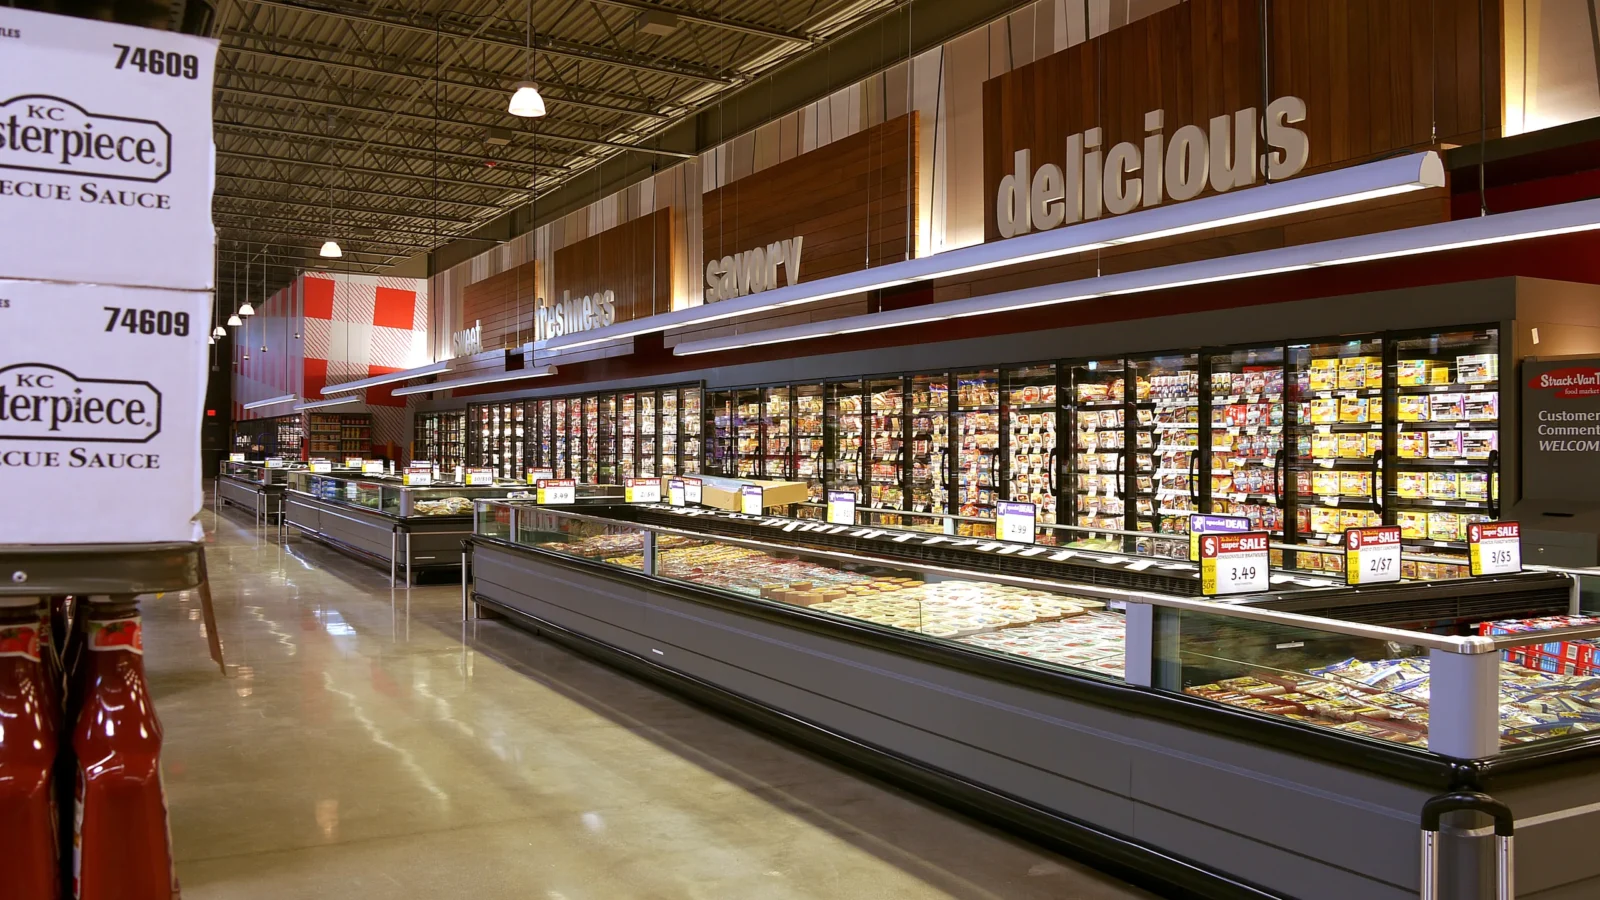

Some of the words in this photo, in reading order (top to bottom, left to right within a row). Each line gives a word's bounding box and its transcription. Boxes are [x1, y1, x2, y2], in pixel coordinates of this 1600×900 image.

[113, 44, 199, 80] 74609
[27, 105, 65, 121] KC
[997, 96, 1309, 239] delicious
[706, 236, 804, 304] savory
[104, 306, 190, 337] 74609
[535, 290, 615, 342] freshness
[454, 320, 484, 357] sweet
[16, 374, 54, 388] KC
[1538, 410, 1600, 421] Customer
[1539, 440, 1600, 452] WELCOM
[0, 450, 60, 468] CUE
[1225, 519, 1248, 530] DEAL
[1497, 526, 1518, 537] SALE
[1220, 542, 1240, 550] super
[1240, 538, 1267, 550] SALE
[1378, 531, 1399, 543] SALE
[1370, 557, 1392, 572] 2/$7
[1492, 550, 1511, 564] 3/$5
[1231, 566, 1256, 581] 3.49
